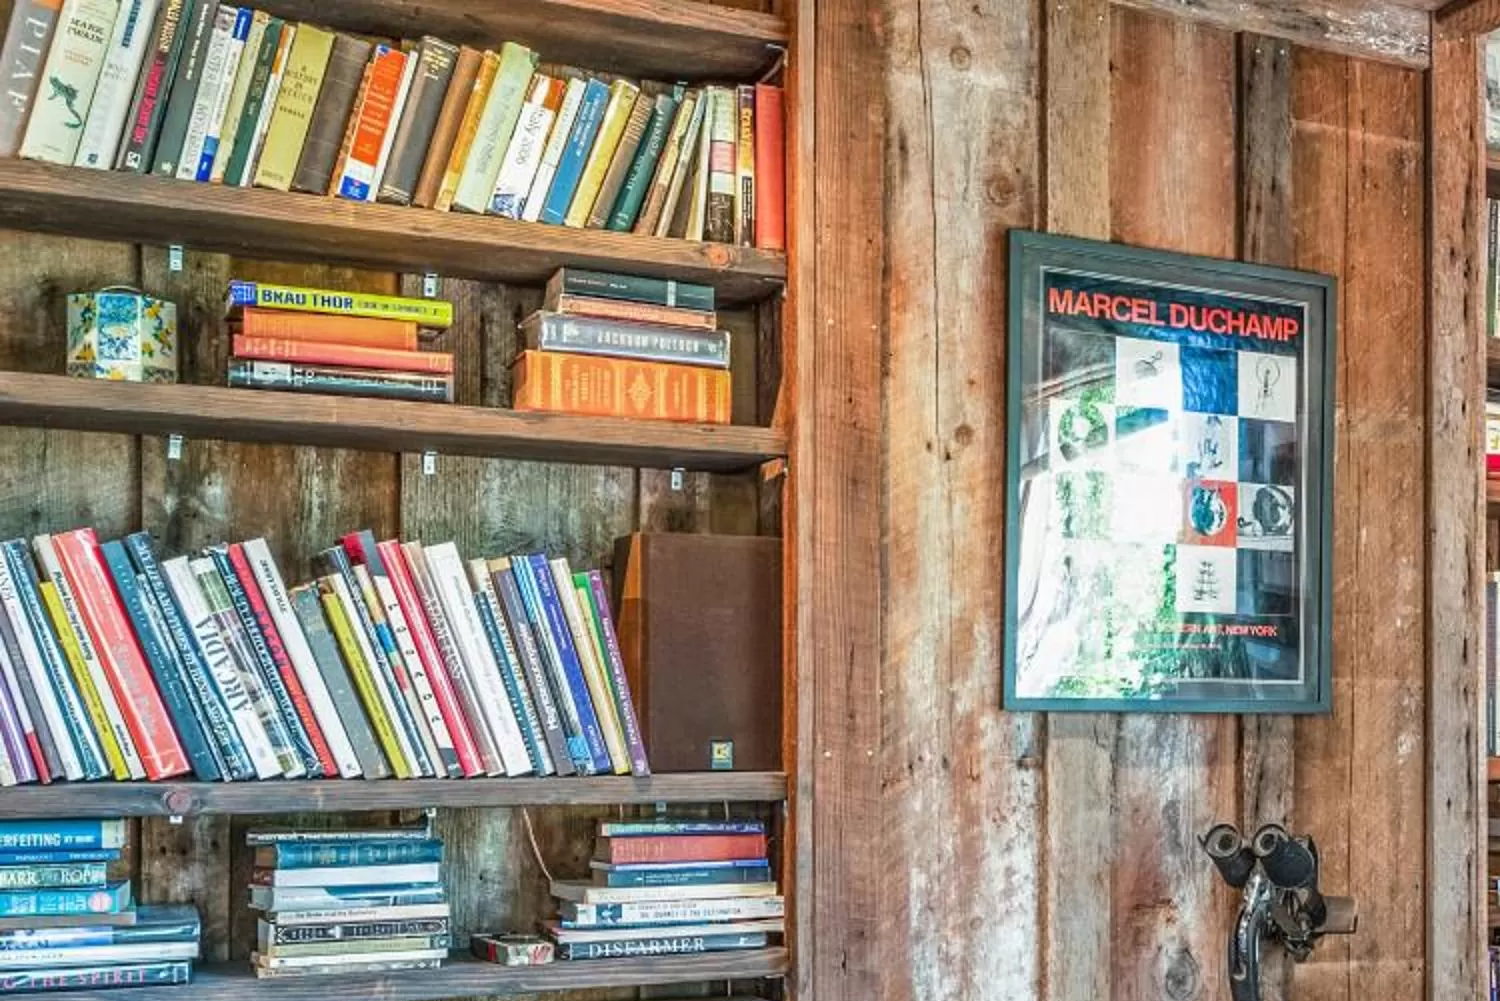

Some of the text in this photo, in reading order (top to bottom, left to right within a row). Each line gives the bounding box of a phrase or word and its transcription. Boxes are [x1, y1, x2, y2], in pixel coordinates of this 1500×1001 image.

[262, 289, 306, 305] BRAD
[311, 293, 354, 310] THOR
[1048, 287, 1299, 342] MARCEL DUCHAMP
[1249, 625, 1277, 637] YORK
[193, 614, 252, 716] ARCADIA
[589, 937, 705, 959] DISFARMER
[78, 968, 146, 985] SPIRIT
